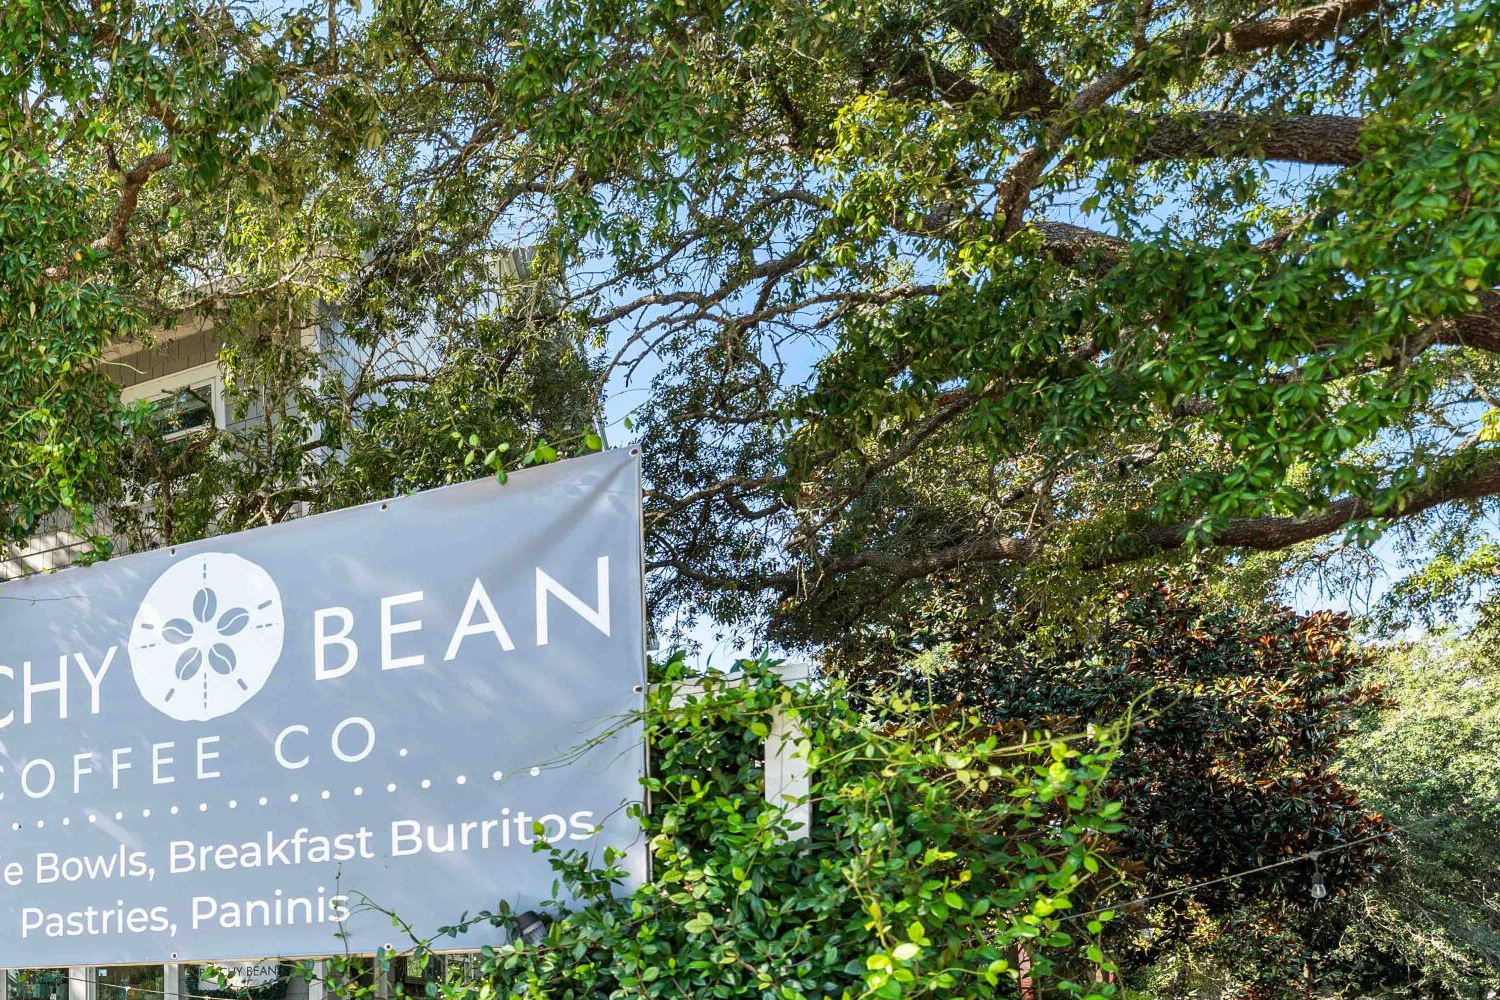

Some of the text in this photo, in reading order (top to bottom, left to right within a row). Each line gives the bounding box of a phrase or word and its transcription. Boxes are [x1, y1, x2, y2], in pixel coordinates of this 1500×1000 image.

[313, 556, 611, 681] BEAN
[273, 716, 409, 769] CO.
[36, 844, 156, 883] Bowls,
[169, 826, 375, 874] Breakfast
[391, 807, 596, 857] Burritos
[21, 886, 351, 938] Pastries, Paninis
[246, 965, 277, 976] BEAN
